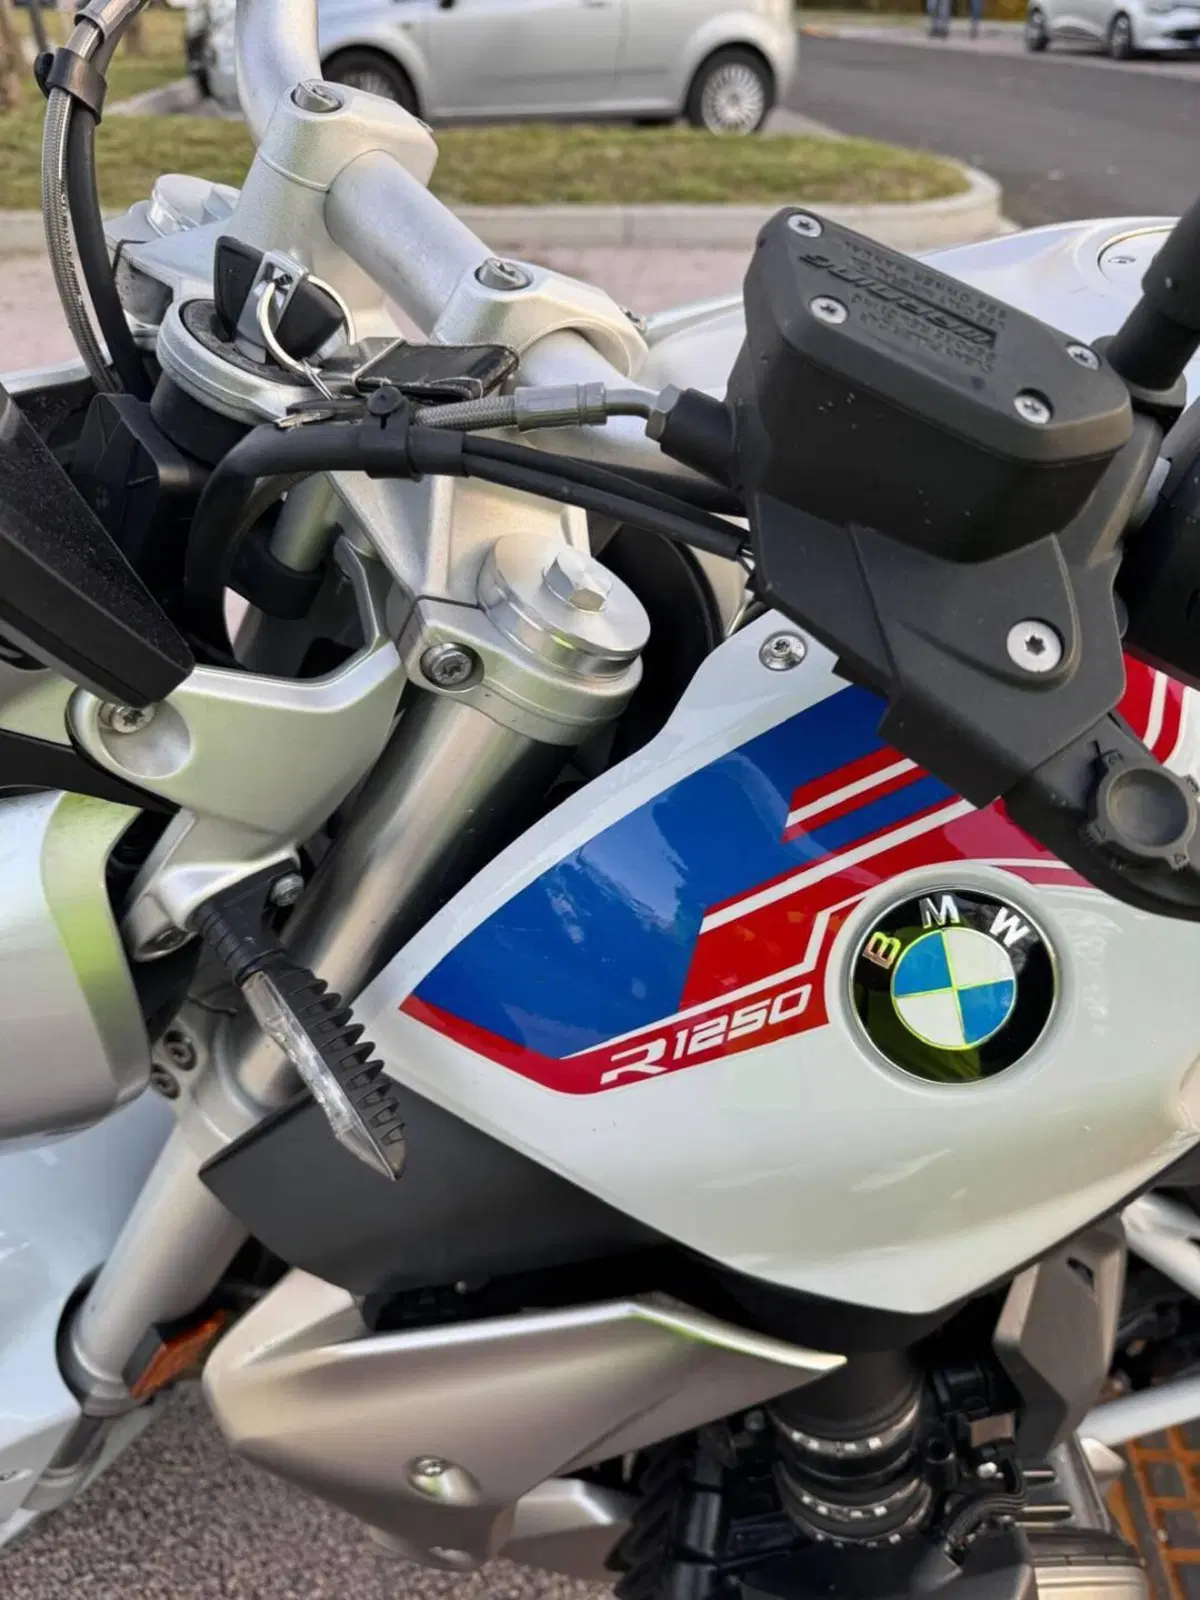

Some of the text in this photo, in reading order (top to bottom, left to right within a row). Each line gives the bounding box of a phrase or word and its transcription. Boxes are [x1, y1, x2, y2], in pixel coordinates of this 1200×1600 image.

[862, 895, 1030, 970] BMW
[600, 983, 813, 1085] R 1250
